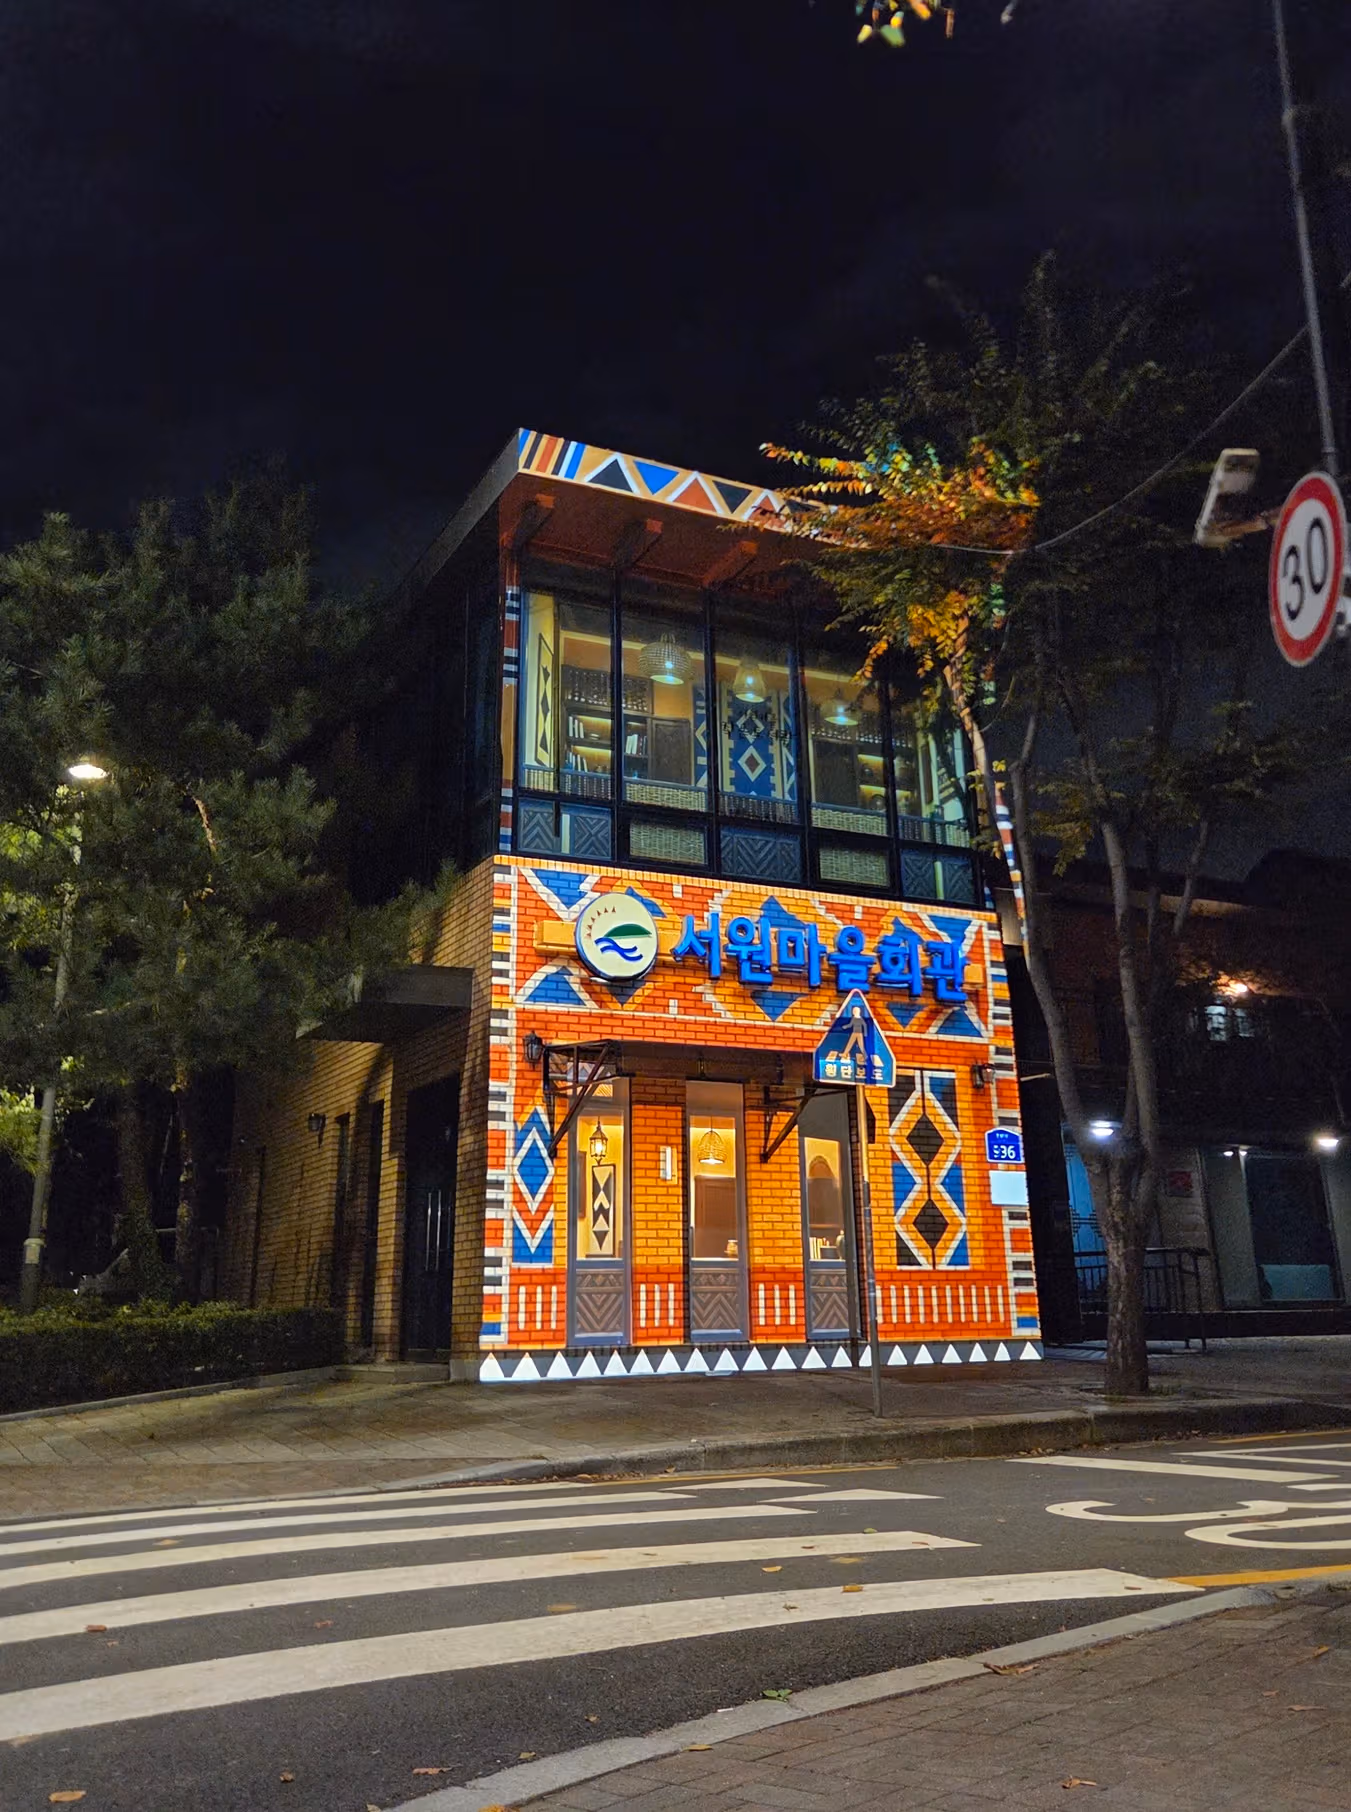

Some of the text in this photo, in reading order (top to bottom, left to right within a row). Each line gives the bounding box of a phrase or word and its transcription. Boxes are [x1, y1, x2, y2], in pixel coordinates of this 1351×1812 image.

[1283, 516, 1328, 621] 30
[671, 912, 969, 1002] 서원마을회관
[825, 1063, 883, 1081] 횡단보도
